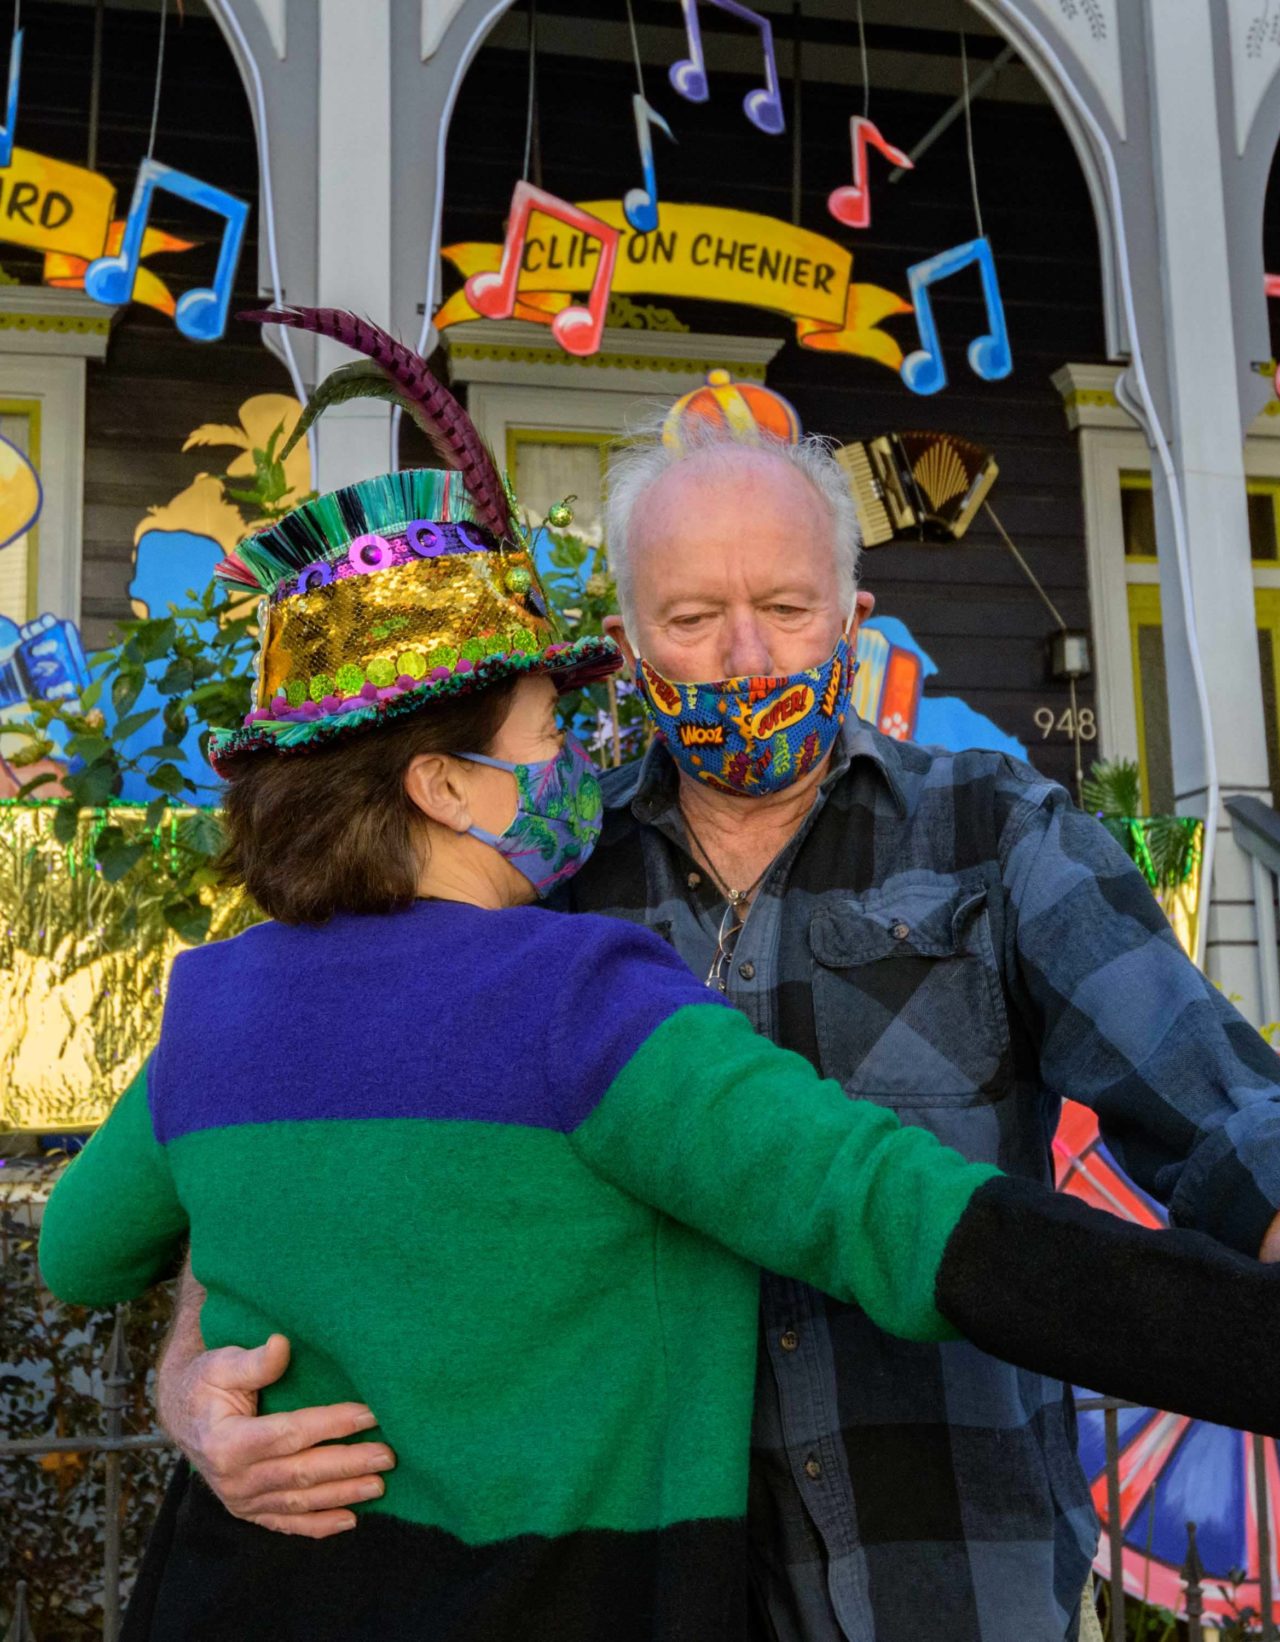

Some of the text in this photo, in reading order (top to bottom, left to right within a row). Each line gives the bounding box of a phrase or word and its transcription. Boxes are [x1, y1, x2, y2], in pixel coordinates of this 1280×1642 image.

[0, 176, 73, 230] RD
[522, 229, 837, 294] CLIFON CHENIER
[681, 725, 723, 747] WOOZ
[758, 685, 808, 737] SUPER!
[1034, 707, 1097, 741] 948
